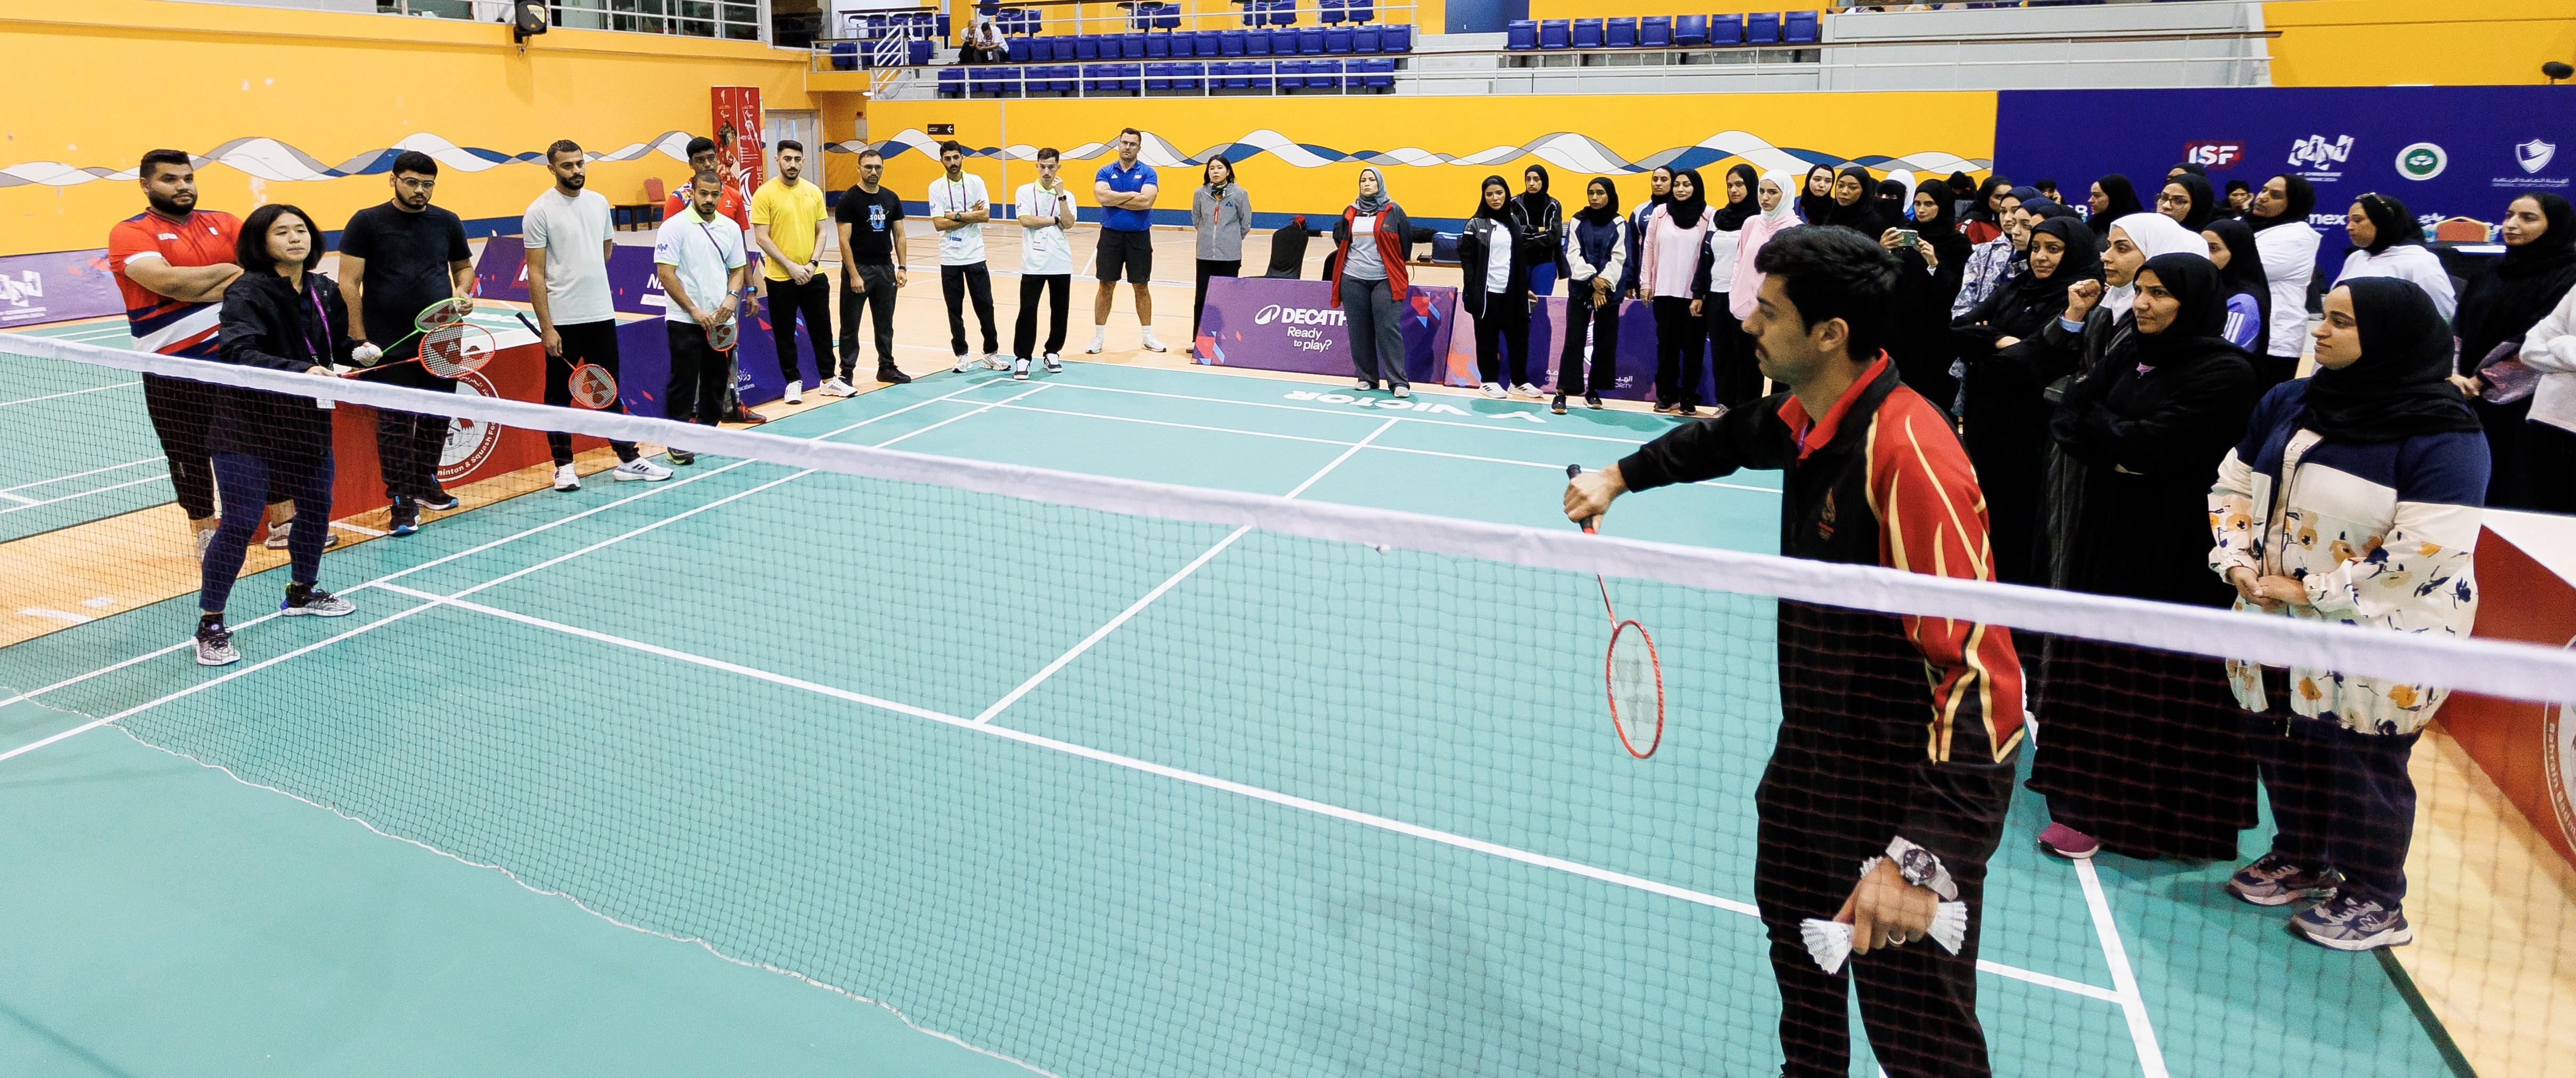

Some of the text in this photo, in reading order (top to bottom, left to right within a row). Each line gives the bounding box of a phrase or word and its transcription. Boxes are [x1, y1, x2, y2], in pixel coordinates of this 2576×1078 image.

[2189, 146, 2239, 165] ISF
[1287, 326, 1323, 340] Ready
[1303, 339, 1332, 352] play?
[1283, 390, 1473, 417] VICTOR
[470, 436, 492, 463] Squash
